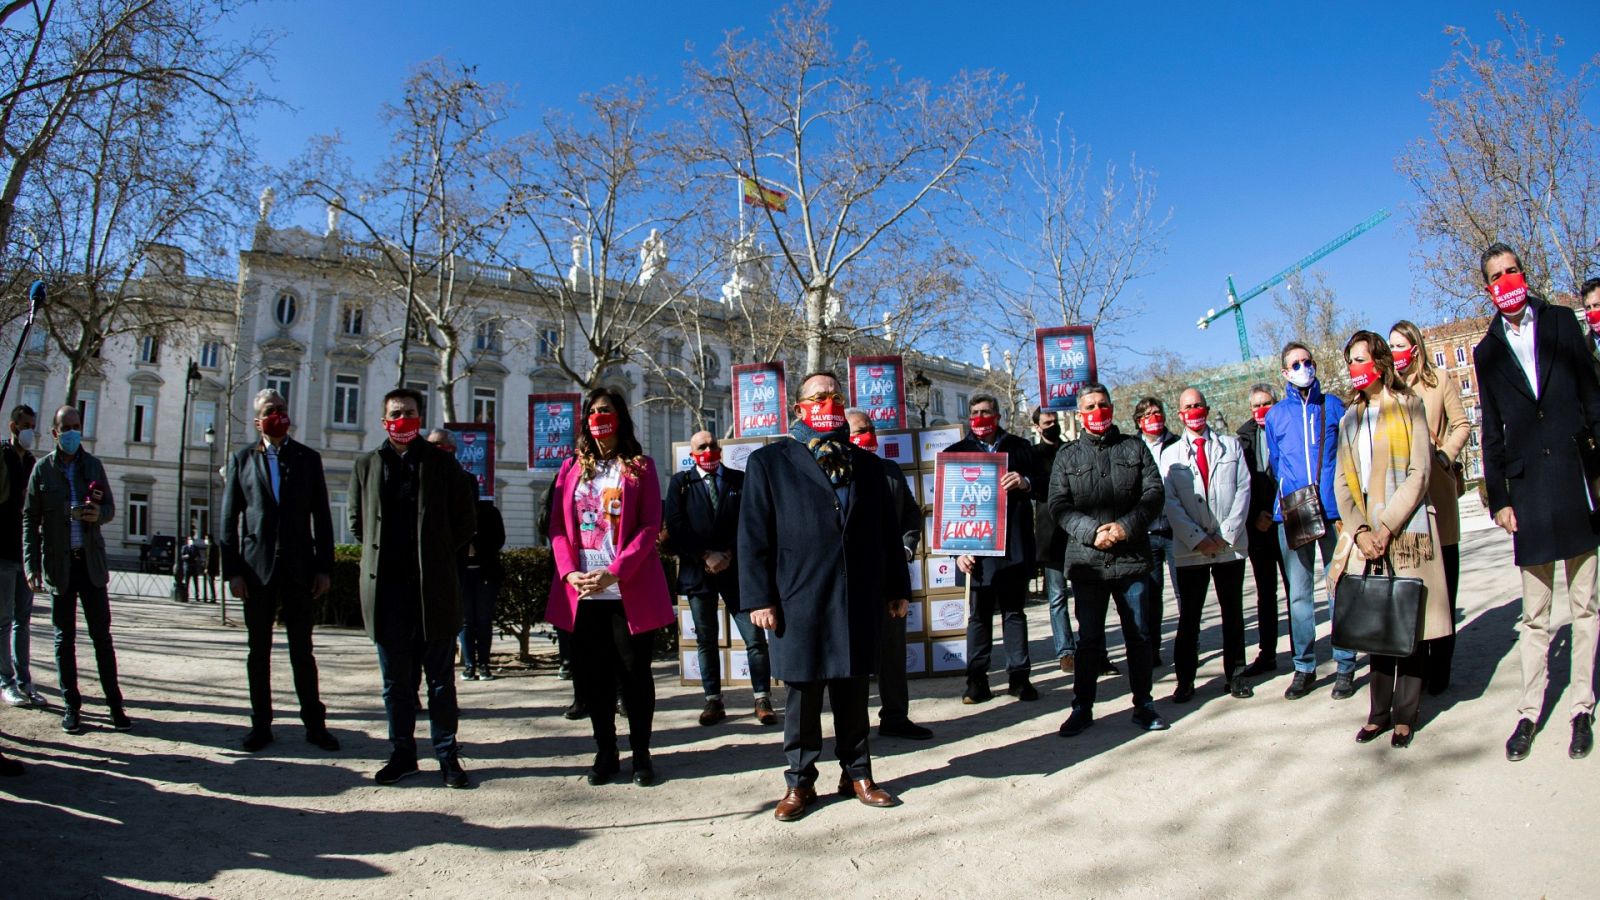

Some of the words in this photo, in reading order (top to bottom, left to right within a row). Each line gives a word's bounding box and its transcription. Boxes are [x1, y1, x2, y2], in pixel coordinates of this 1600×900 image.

[1060, 351, 1084, 369] AÑO
[752, 386, 775, 402] AÑO
[870, 379, 893, 395] AÑO
[811, 404, 820, 414] #
[866, 406, 896, 422] UCHA
[548, 416, 571, 433] AÑO
[961, 482, 991, 505] AÑO
[943, 520, 993, 541] LUCHA
